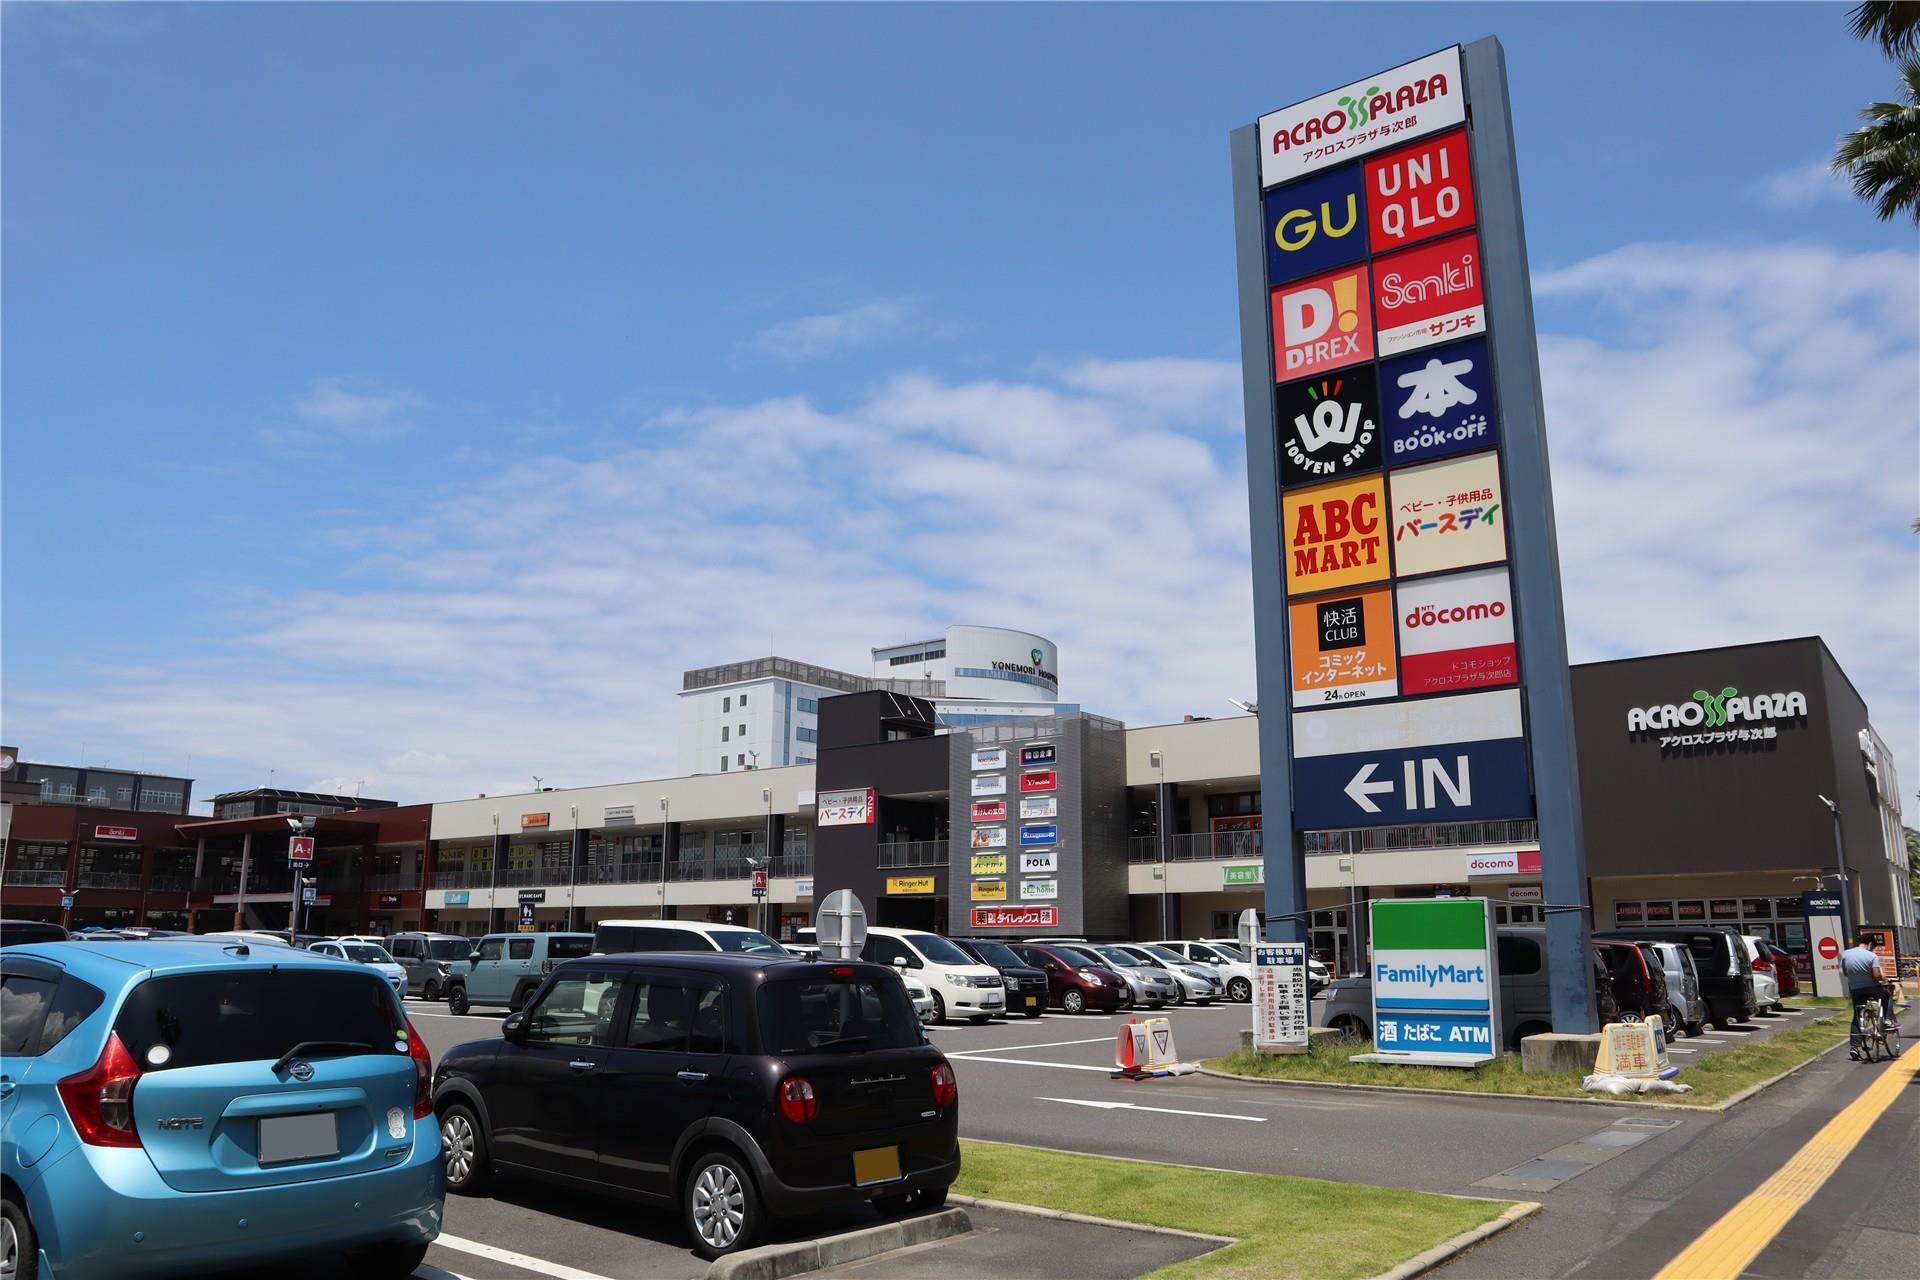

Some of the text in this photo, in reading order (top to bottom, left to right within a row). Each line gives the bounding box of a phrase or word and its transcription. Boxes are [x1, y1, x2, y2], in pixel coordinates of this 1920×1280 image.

[1303, 115, 1417, 163] アクロスプラザ与次郎
[1378, 147, 1450, 197] UNI
[1275, 193, 1357, 252] GU
[1381, 186, 1460, 239] QLO
[1381, 254, 1475, 310] Sanki
[1429, 314, 1476, 337] サンキ
[1285, 331, 1361, 371] D!REX
[1396, 358, 1478, 419] 本
[1284, 418, 1376, 475] 100YEN SHOP
[1400, 488, 1493, 513] ベビー・子供用品
[1293, 492, 1379, 547] ABC
[1396, 504, 1500, 541] バースデイ
[1294, 536, 1380, 577] MART
[1323, 607, 1357, 628] 快活
[1405, 601, 1506, 629] docomo
[1420, 604, 1435, 612] NTT
[1325, 626, 1358, 642] CLUB
[991, 660, 1035, 675] YONEMORI
[1318, 650, 1367, 669] コミック
[1451, 655, 1512, 671] ドコモショップ
[1302, 662, 1388, 685] インターネット
[1423, 669, 1512, 687] アクロスプラザ与次郎店
[1343, 690, 1366, 699] OPEN
[1659, 726, 1778, 748] アクロスプラザ与次郎
[1403, 754, 1472, 811] IN
[820, 806, 865, 821] バースデイ
[867, 796, 873, 817] 2F
[1026, 858, 1051, 867] POLA
[1470, 859, 1514, 869] docomo
[898, 880, 917, 888] Ringer
[917, 879, 929, 887] Hut
[997, 912, 1039, 924] ダイレックス
[1257, 948, 1303, 956] お客様専用
[1266, 957, 1294, 965] 駐車場
[1377, 964, 1484, 988] FamilyMart
[1379, 1020, 1489, 1043] 酒 たばこ ATM
[1616, 1052, 1648, 1071] 満車
